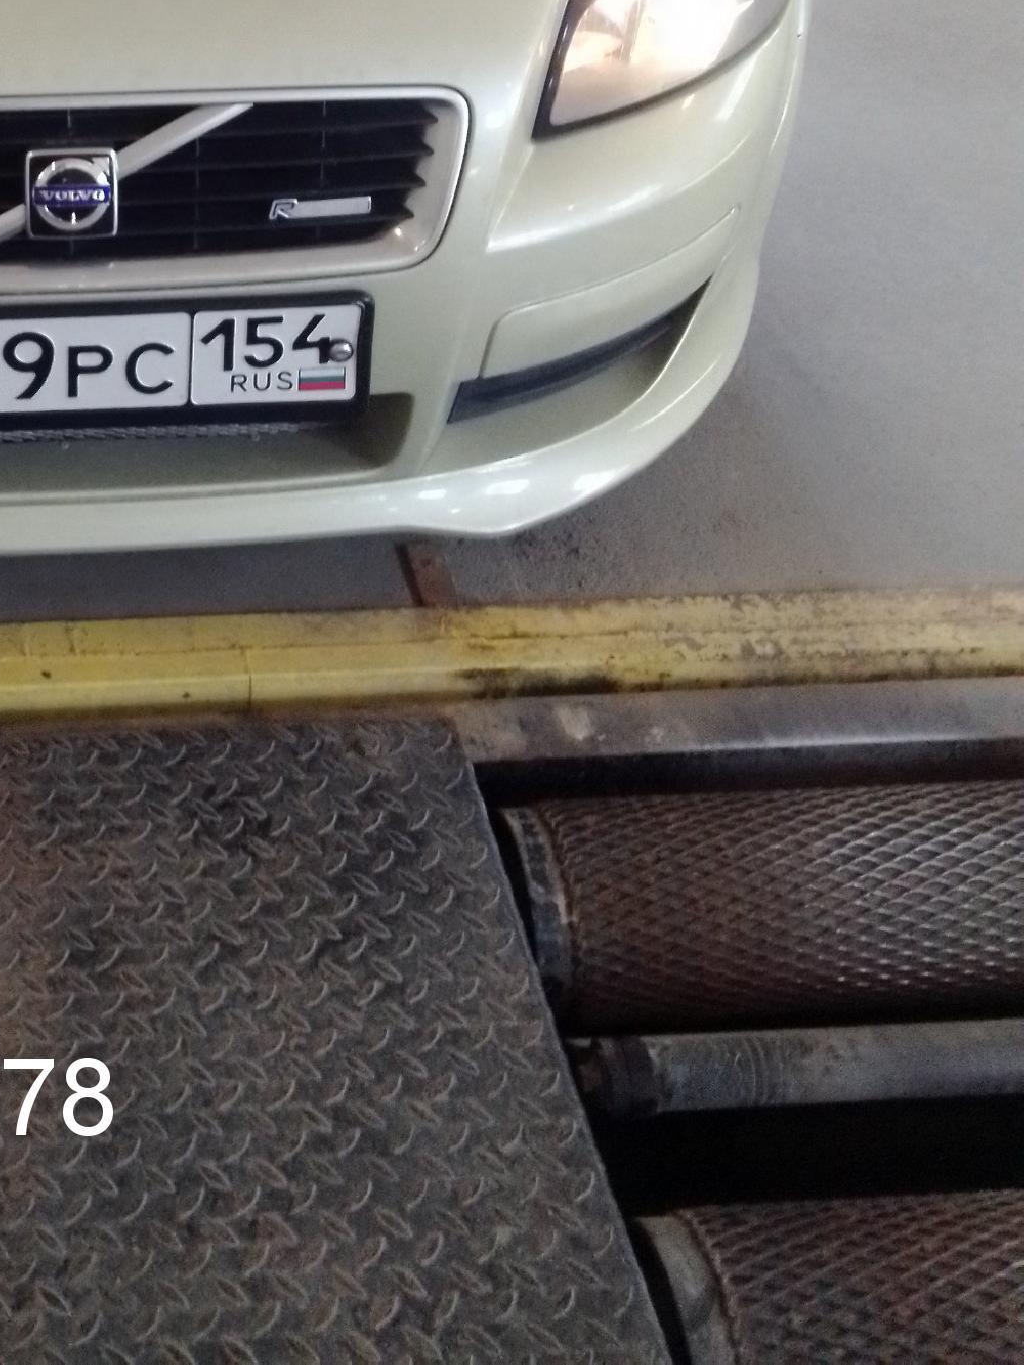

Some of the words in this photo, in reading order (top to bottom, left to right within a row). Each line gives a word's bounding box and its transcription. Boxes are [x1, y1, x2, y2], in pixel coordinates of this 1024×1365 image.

[39, 188, 105, 202] VOLVO
[200, 313, 330, 373] 154
[230, 371, 294, 393] RUS
